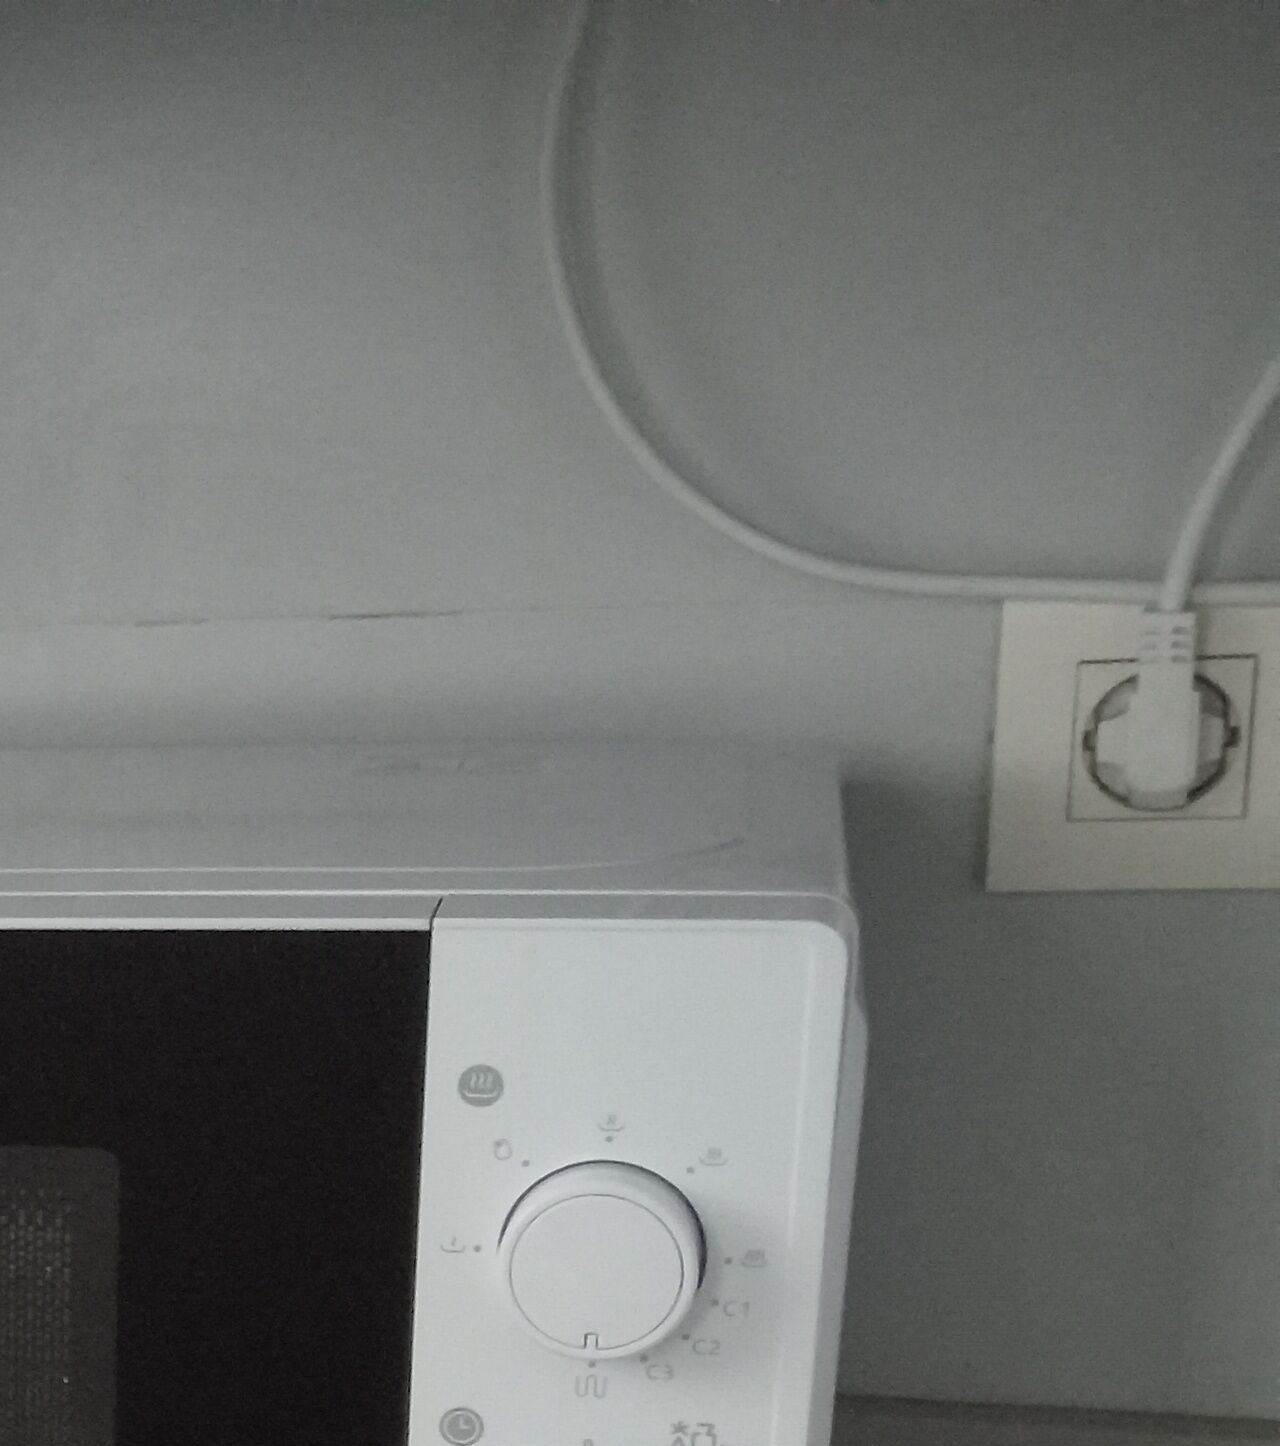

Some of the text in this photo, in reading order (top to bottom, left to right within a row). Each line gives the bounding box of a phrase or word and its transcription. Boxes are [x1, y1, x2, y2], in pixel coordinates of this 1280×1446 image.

[723, 1300, 751, 1318] C1
[692, 1339, 721, 1356] C2
[646, 1364, 674, 1381] C3
